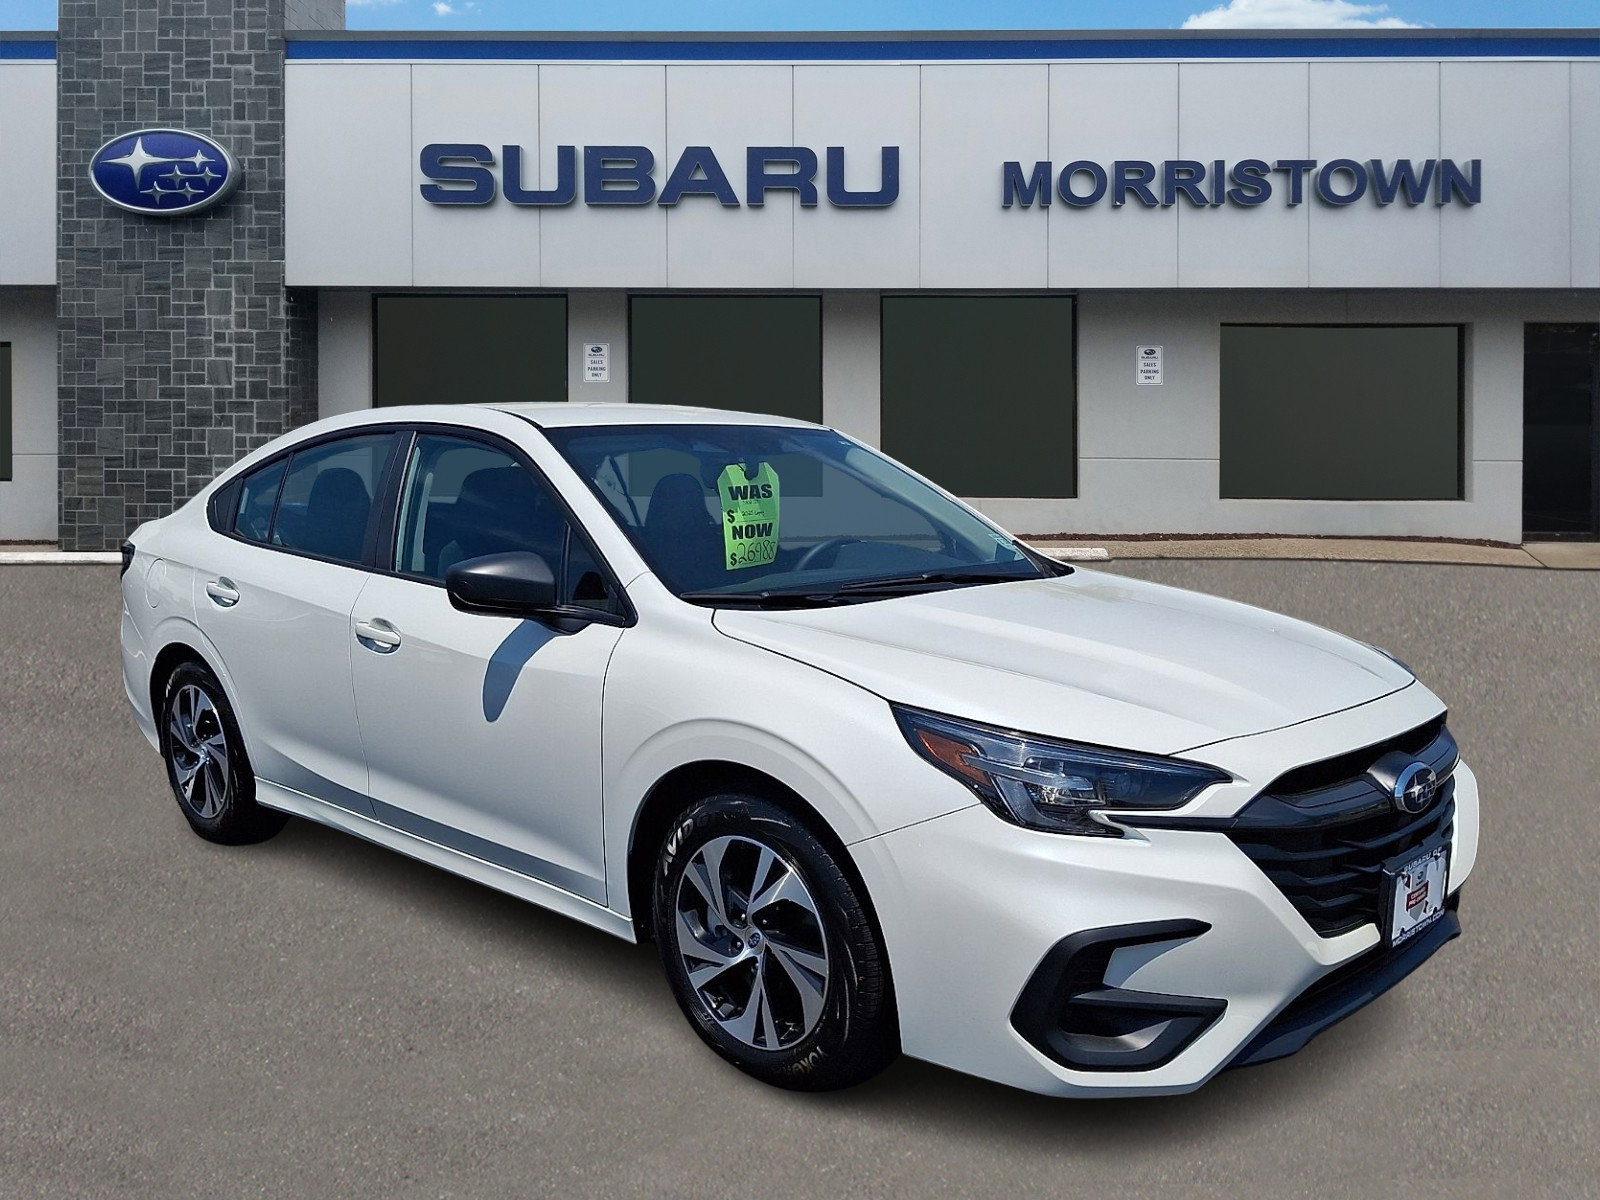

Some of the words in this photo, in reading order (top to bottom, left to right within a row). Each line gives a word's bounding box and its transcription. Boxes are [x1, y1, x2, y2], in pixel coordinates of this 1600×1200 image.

[420, 143, 899, 206] SUBARU
[1001, 159, 1481, 208] MORRISTOWN
[728, 484, 773, 501] WAS
[732, 522, 773, 540] NOW
[1392, 908, 1446, 948] MORRISTOWN.COM
